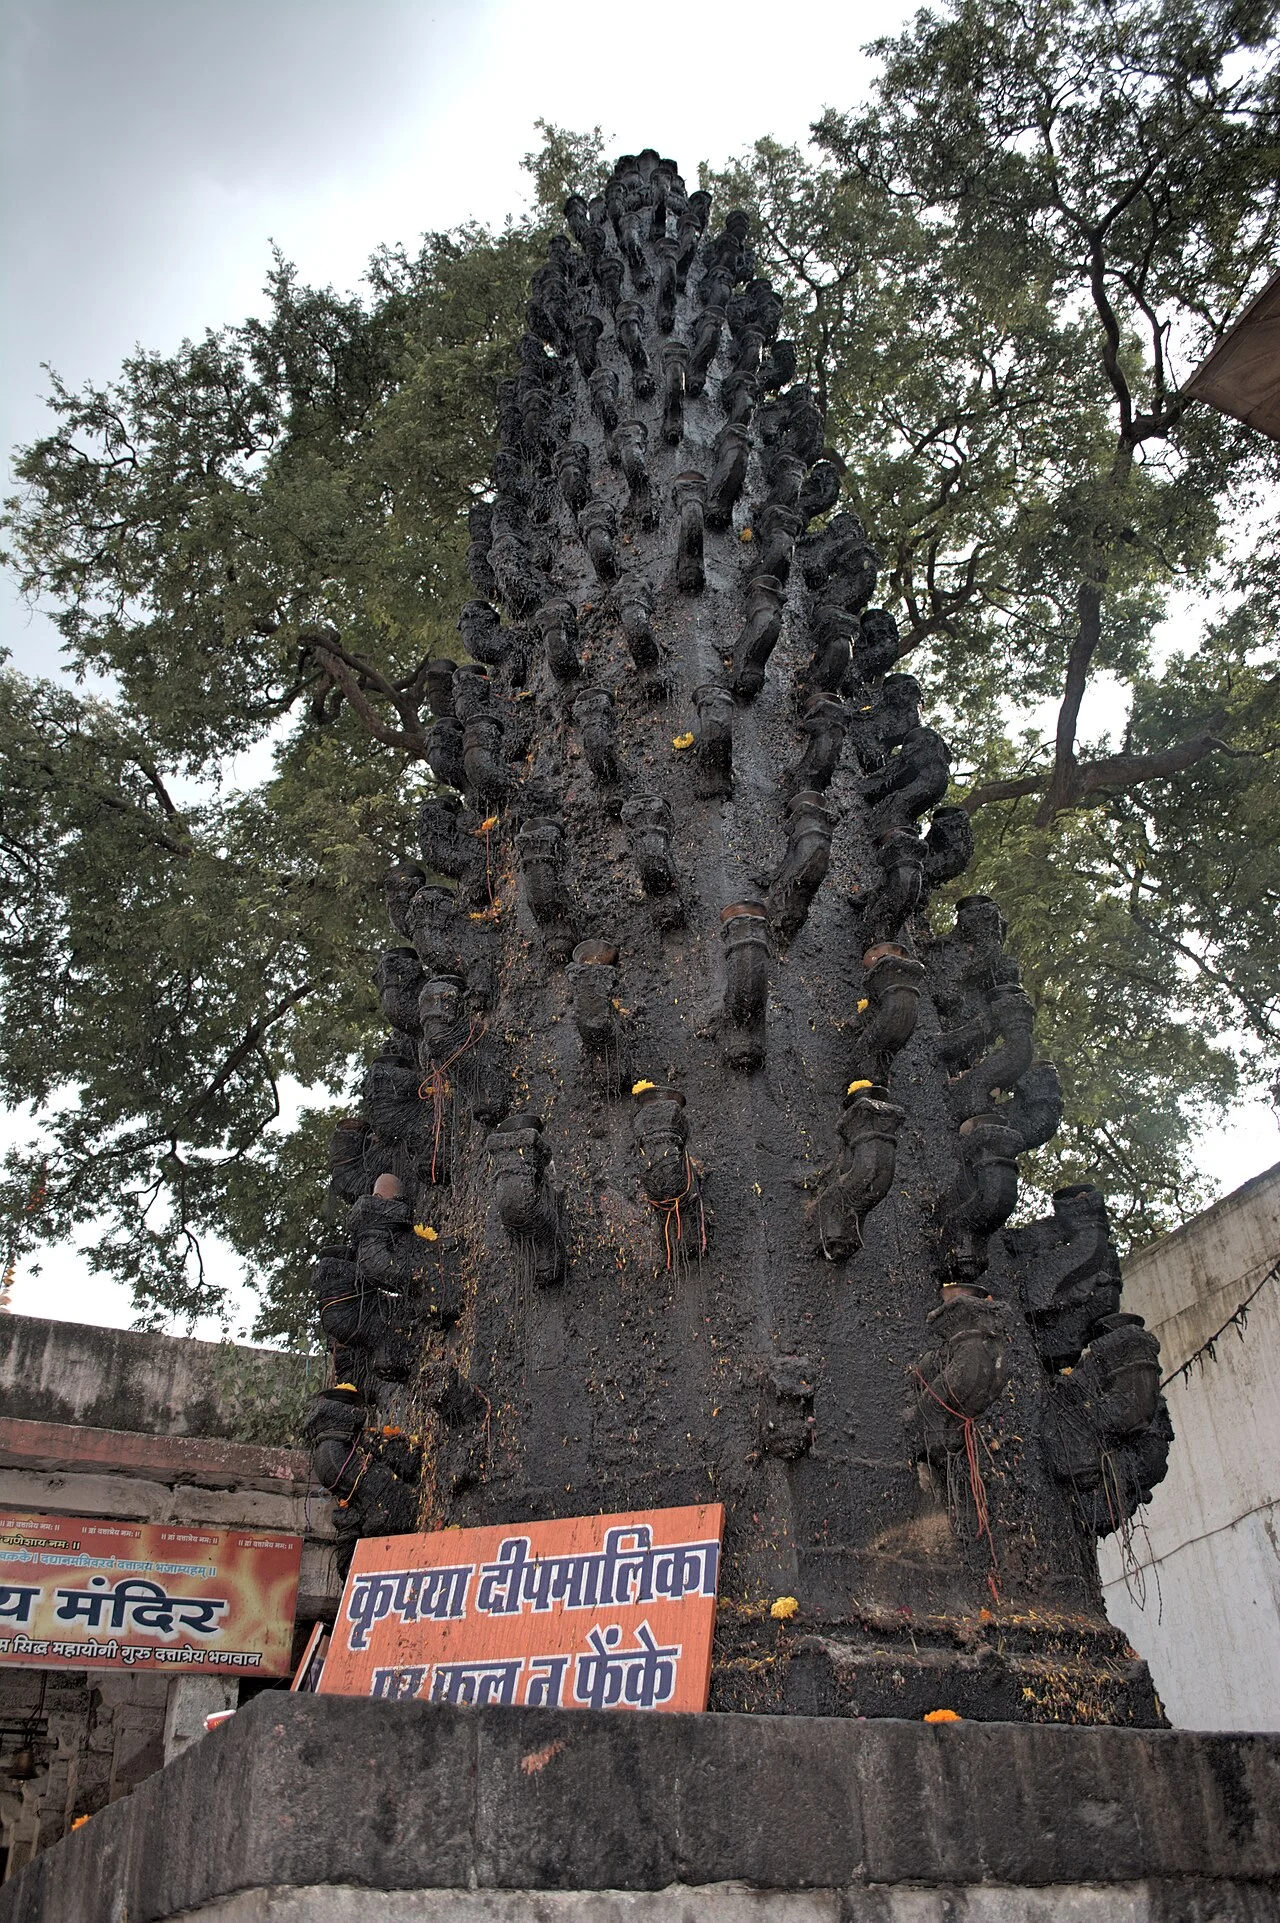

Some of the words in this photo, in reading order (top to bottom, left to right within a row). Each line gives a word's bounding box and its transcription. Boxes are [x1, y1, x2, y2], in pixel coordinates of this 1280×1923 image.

[3, 1534, 46, 1547] गणेशाय
[48, 1540, 69, 1549] नमः
[56, 1576, 226, 1634] मंदिर
[348, 1565, 475, 1651] कृपया
[476, 1523, 720, 1617] दीपमालिका
[13, 1634, 50, 1655] सिद्ध
[52, 1638, 118, 1659] महायोगी
[121, 1645, 153, 1664] गुरु
[155, 1644, 206, 1663] दत्तात्रेय
[208, 1652, 262, 1666] भगवान
